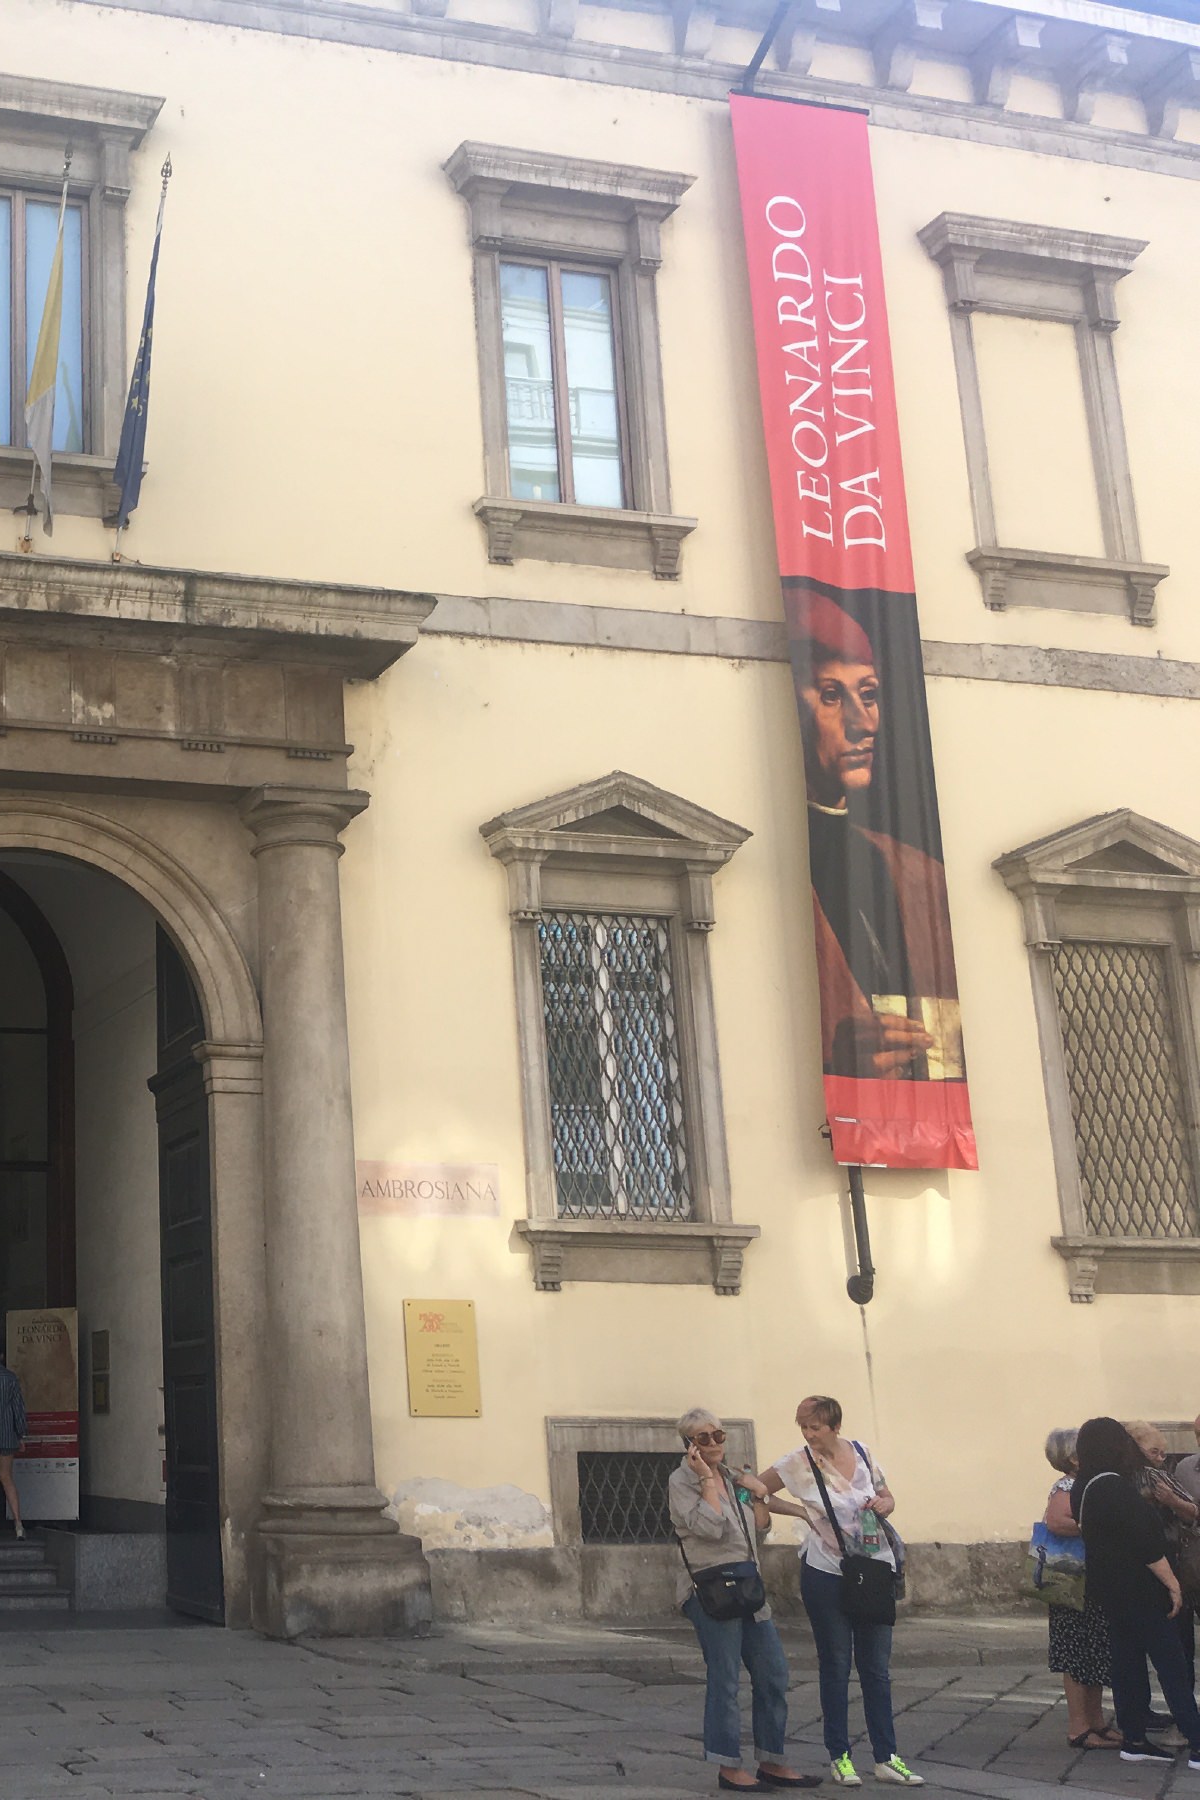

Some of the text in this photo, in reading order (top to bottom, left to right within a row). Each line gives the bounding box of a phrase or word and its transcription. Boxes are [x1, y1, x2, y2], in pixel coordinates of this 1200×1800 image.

[765, 195, 834, 548] LEONARDO
[823, 269, 887, 552] DA VINCI
[361, 1178, 497, 1201] AMBROSIANA
[17, 1324, 67, 1335] LEONARDO
